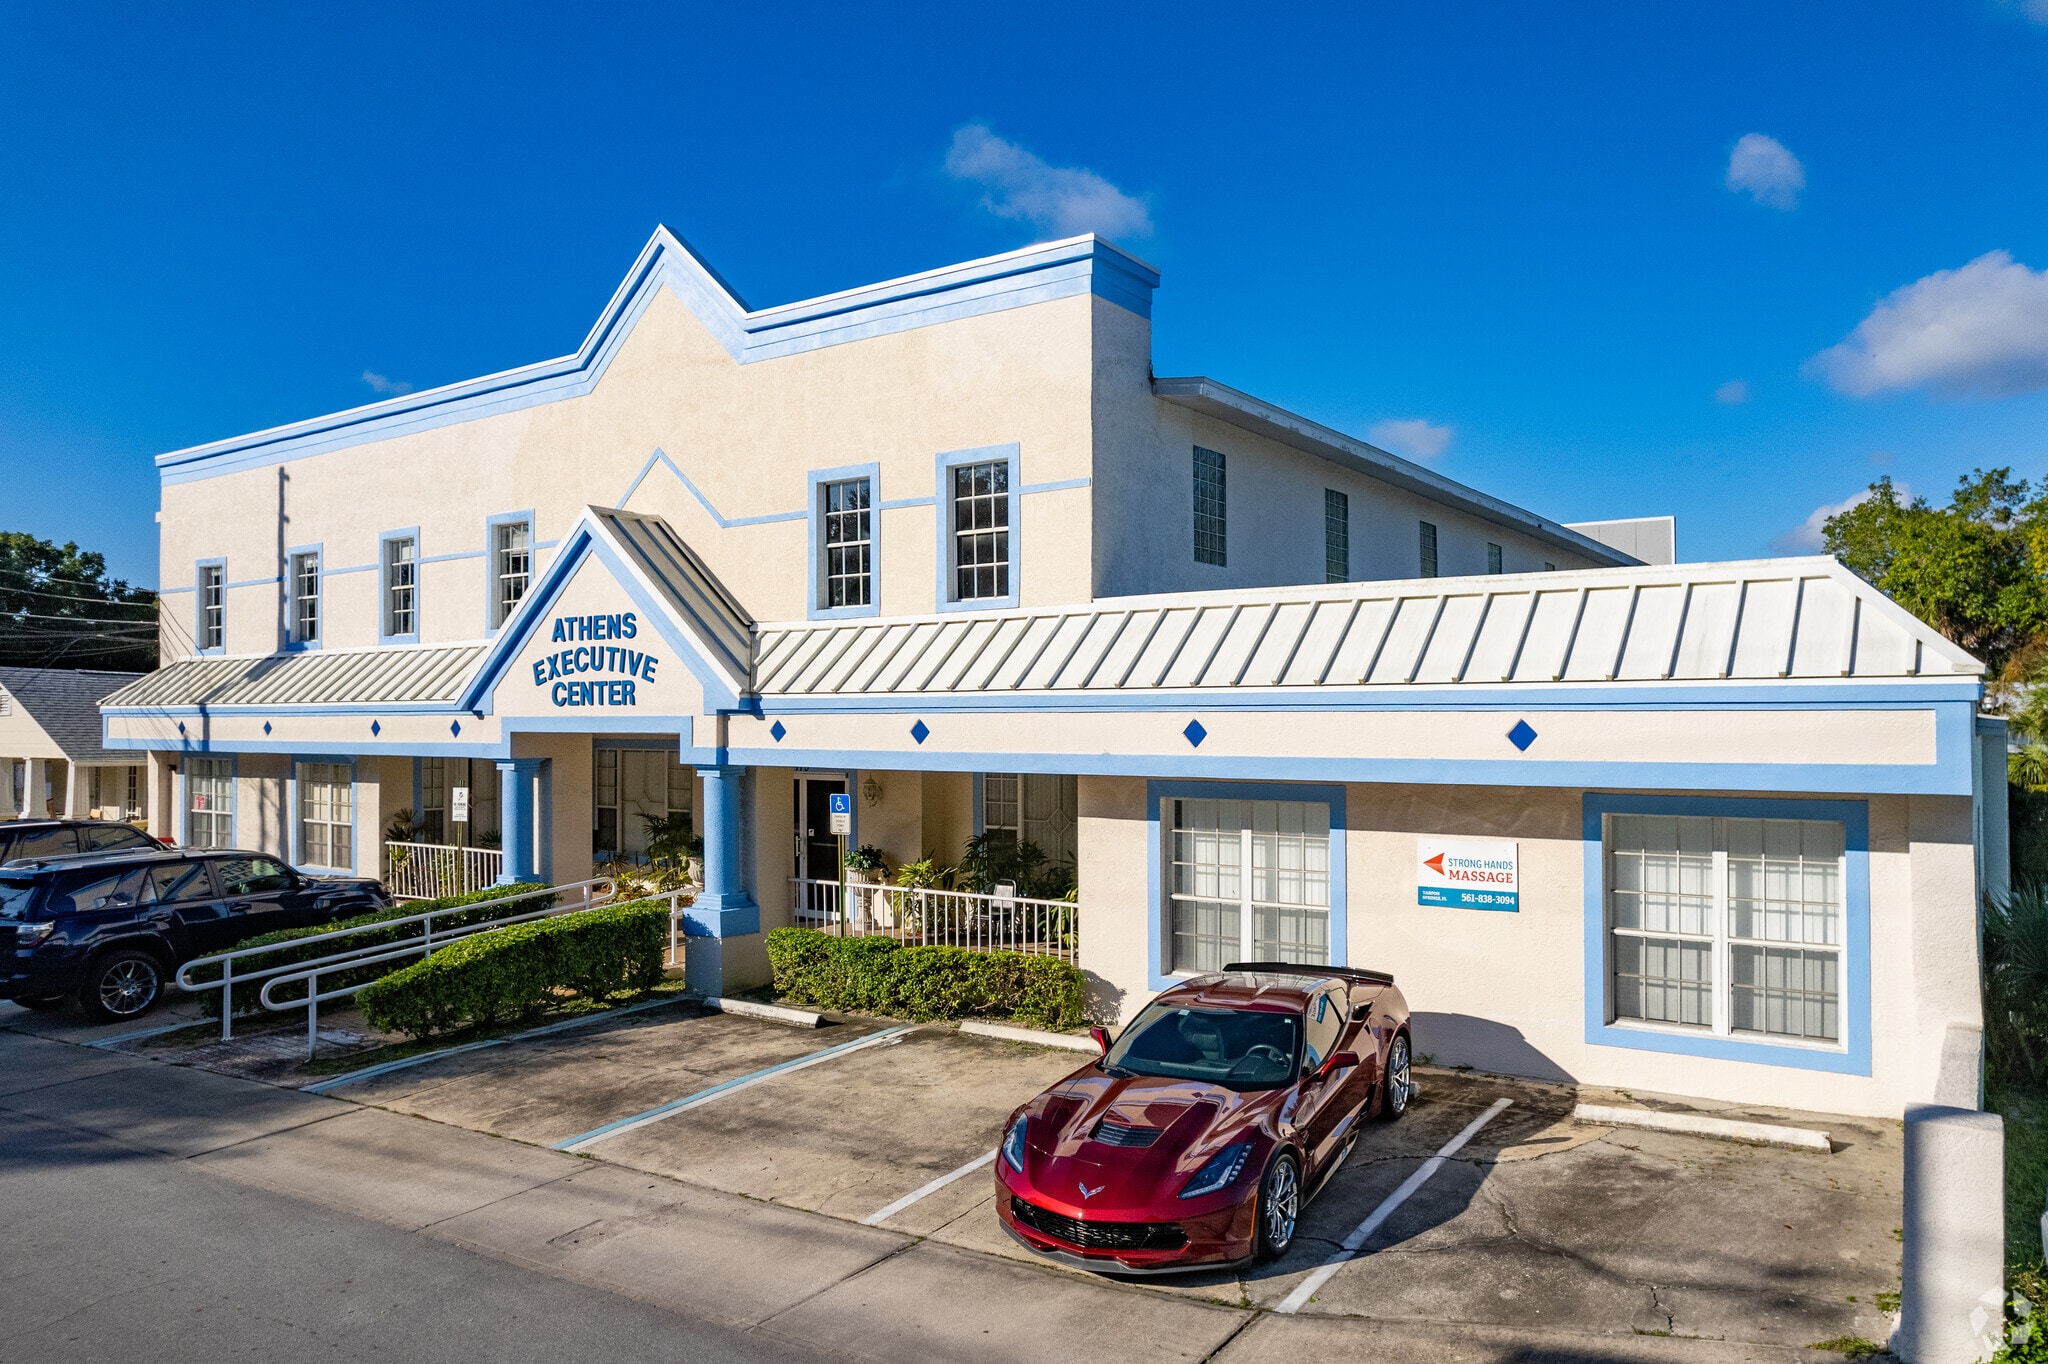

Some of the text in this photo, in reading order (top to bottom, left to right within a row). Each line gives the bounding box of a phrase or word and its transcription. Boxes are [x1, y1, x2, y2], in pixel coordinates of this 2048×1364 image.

[552, 612, 637, 642] ATHENS
[533, 646, 658, 686] EXECUTIVE
[552, 680, 635, 707] CENTER
[1448, 858, 1513, 870] STRONG HANDS
[1449, 869, 1513, 883] MASSAGE
[1461, 893, 1514, 904] 561-838-3094
